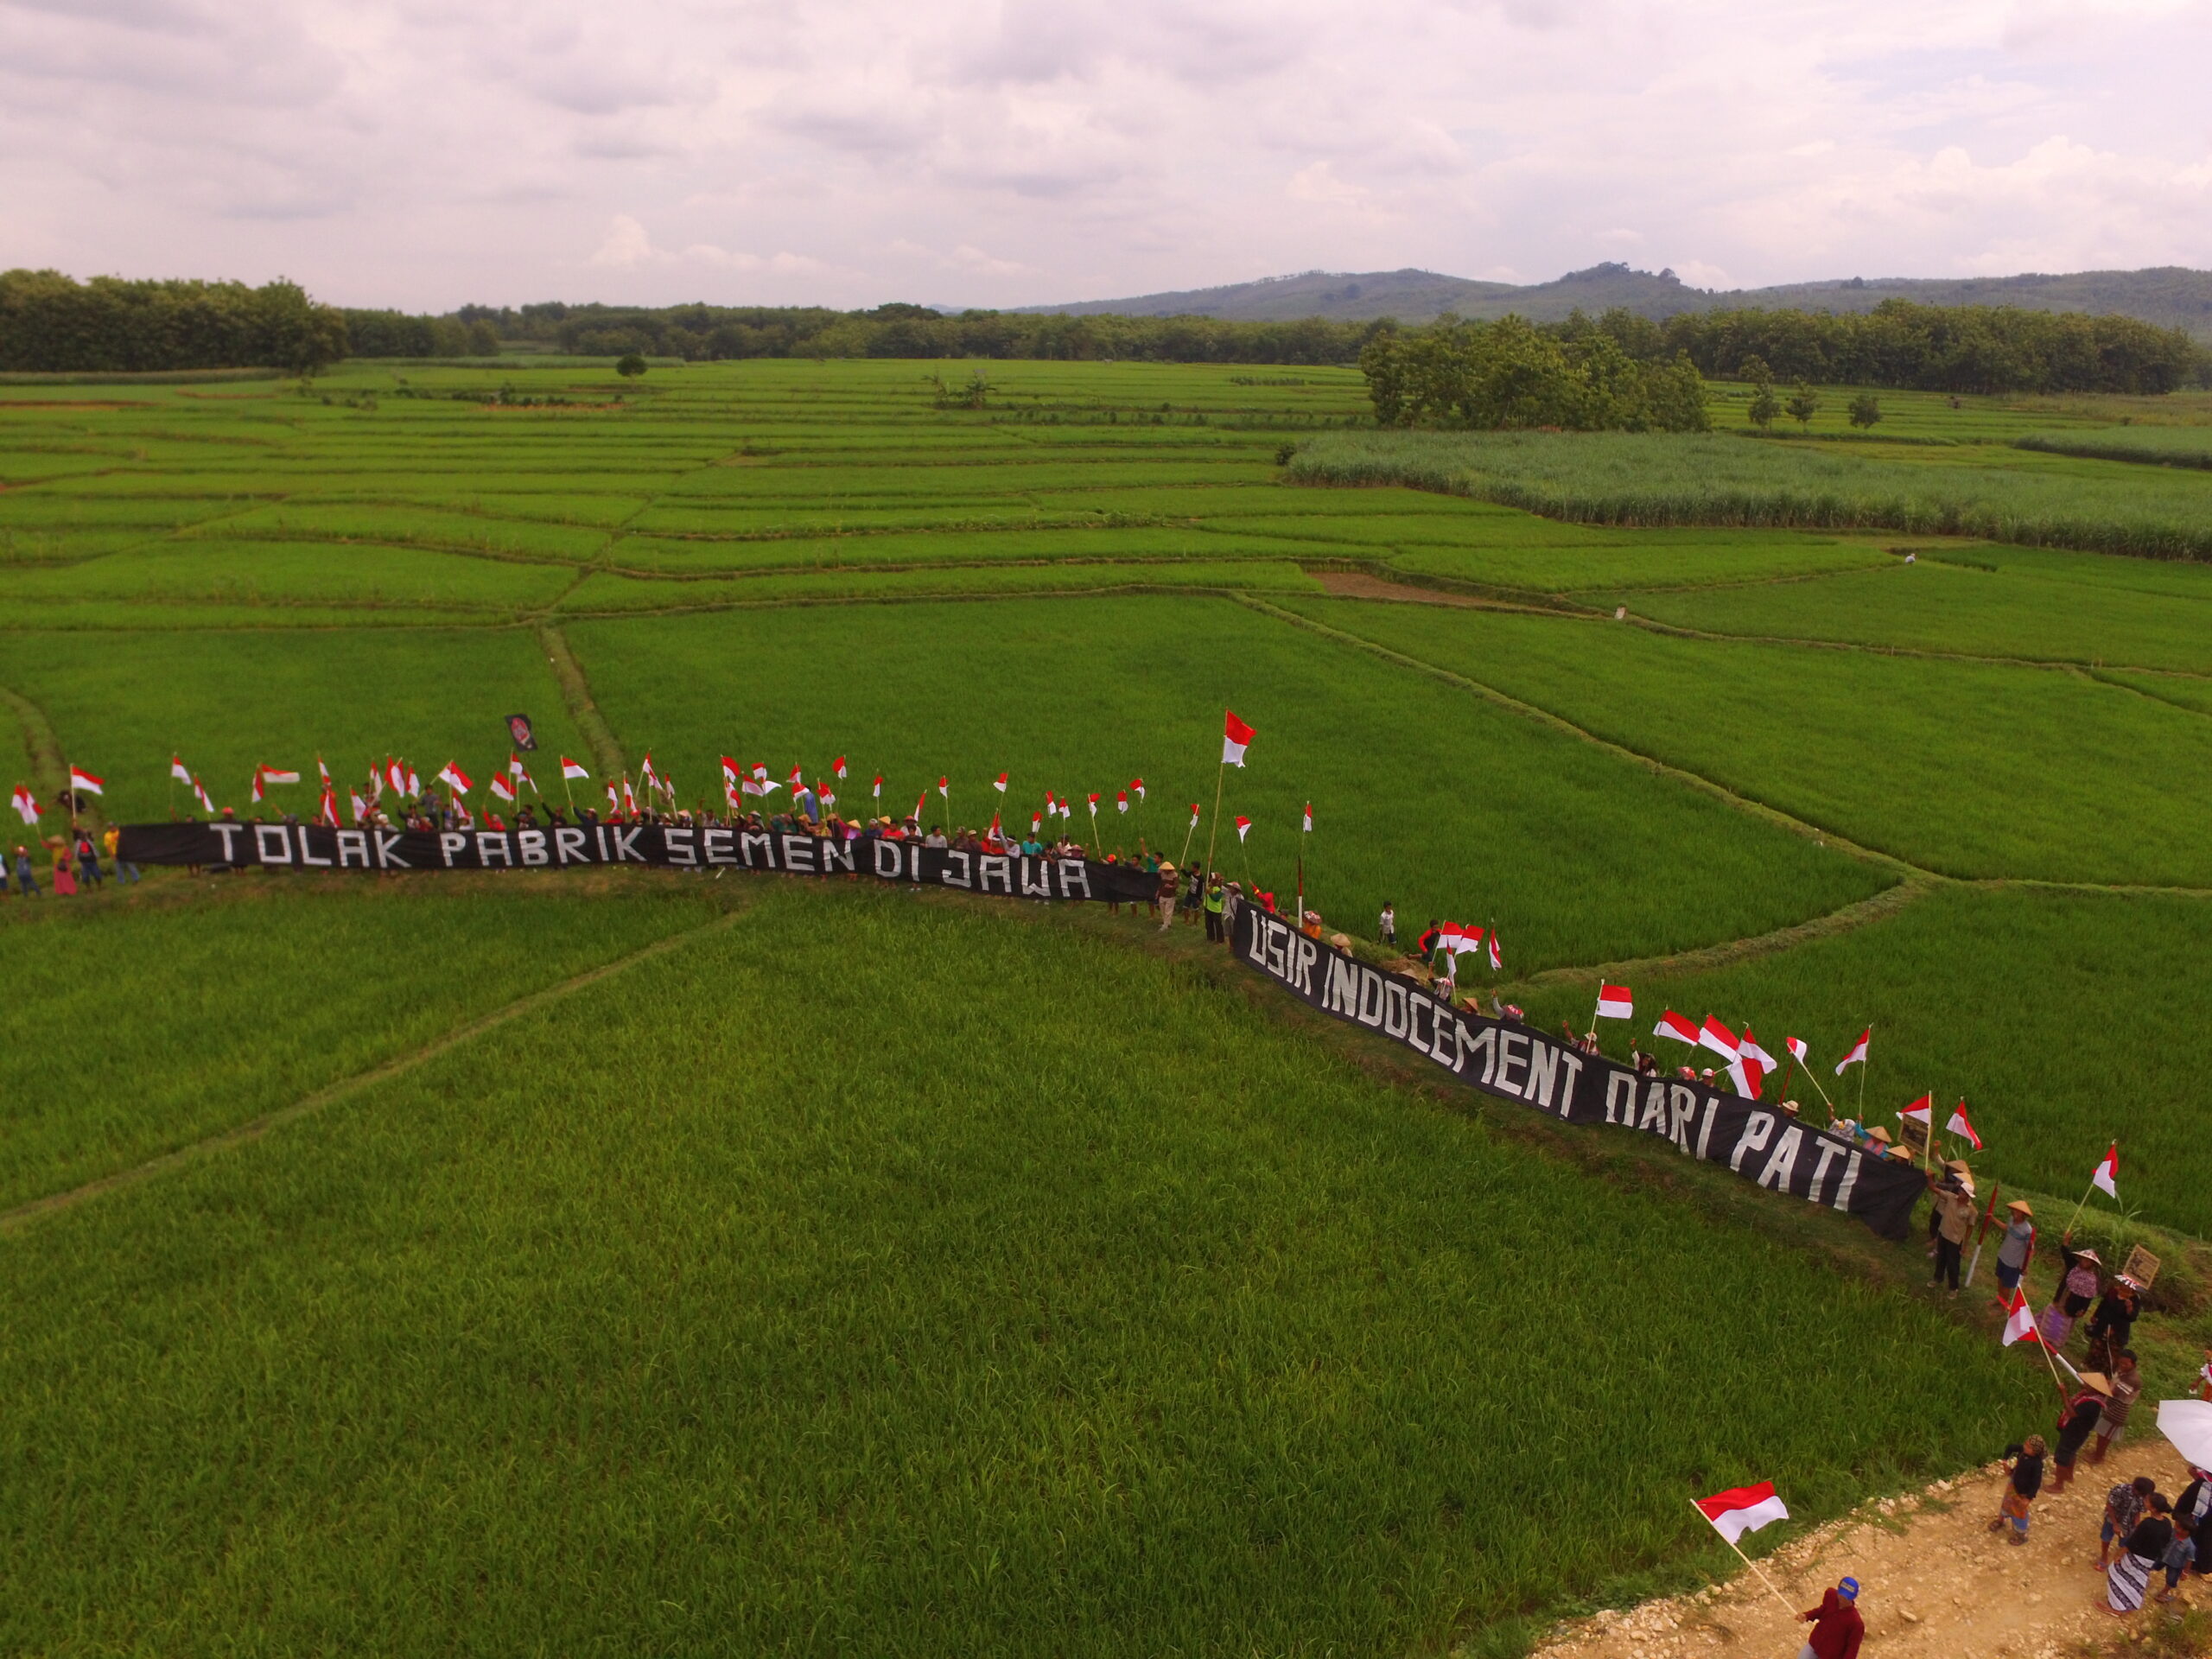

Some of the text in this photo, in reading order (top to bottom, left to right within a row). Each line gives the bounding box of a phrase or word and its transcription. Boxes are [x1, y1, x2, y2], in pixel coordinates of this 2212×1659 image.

[209, 823, 1091, 898] TOLAK PABRIK SEMEN DI JAWA
[1249, 910, 1862, 1211] USIR INDOCEMENT DARI PATI
